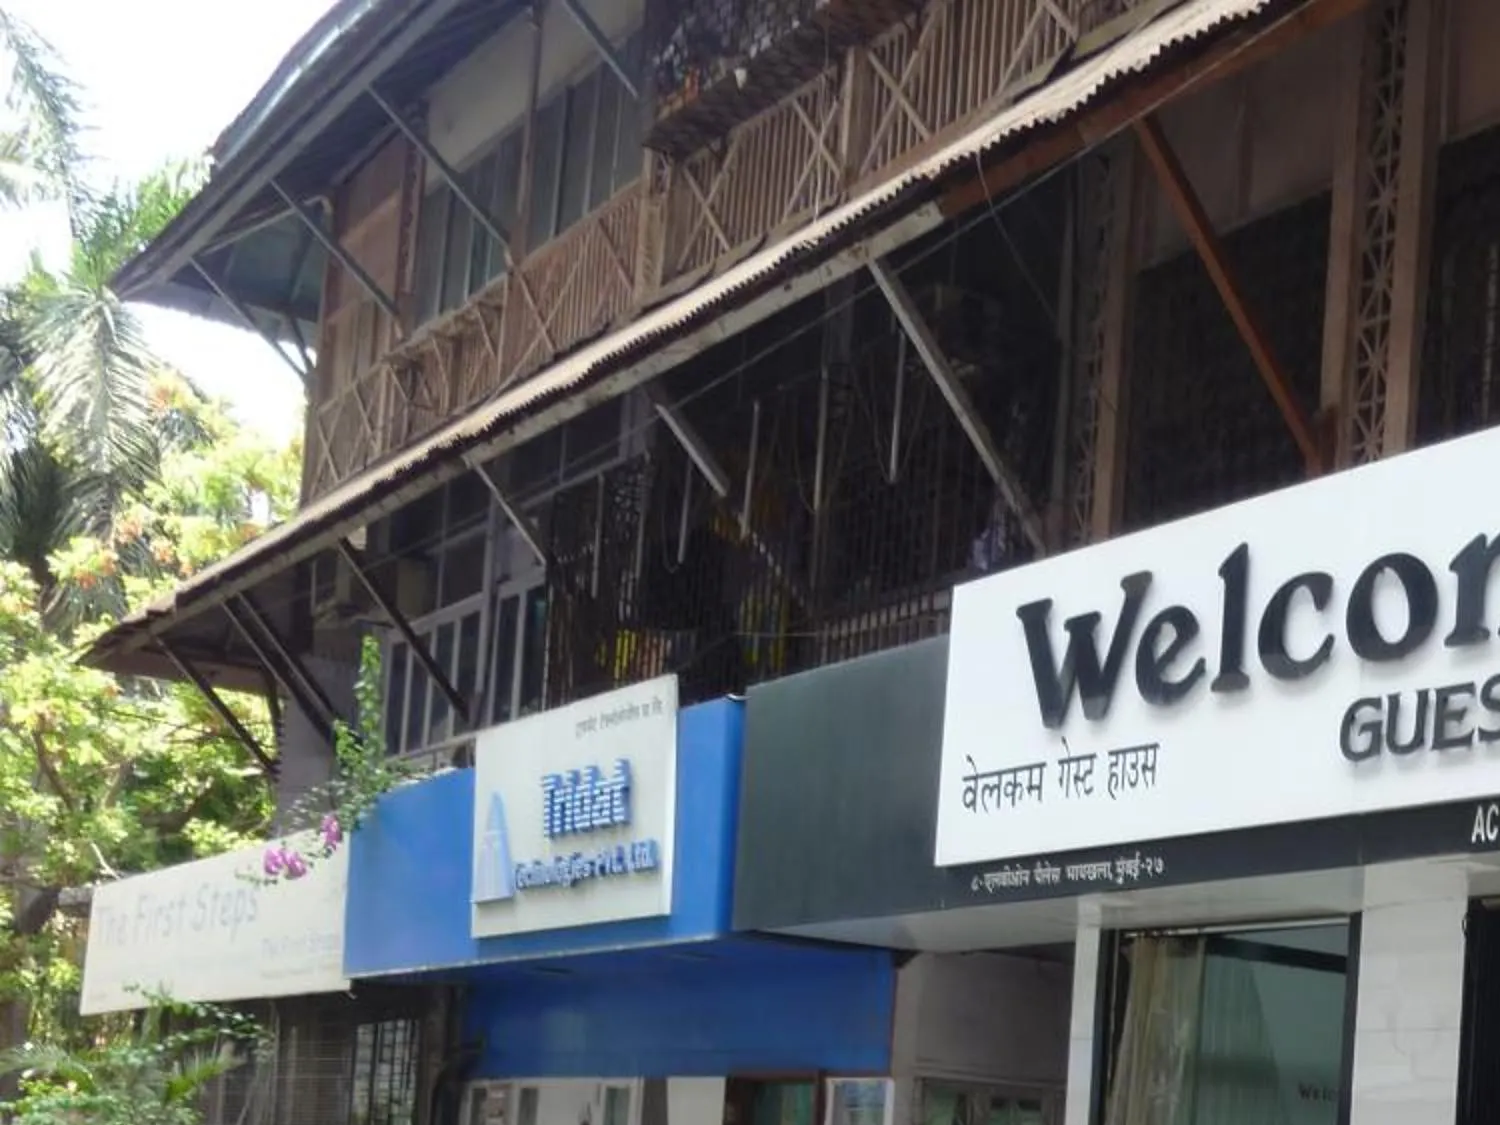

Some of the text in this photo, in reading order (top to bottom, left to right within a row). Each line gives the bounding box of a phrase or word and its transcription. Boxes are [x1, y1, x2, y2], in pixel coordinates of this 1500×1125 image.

[962, 735, 1160, 814] वेलकम गेस्ट हाउस
[1471, 804, 1499, 844] AC
